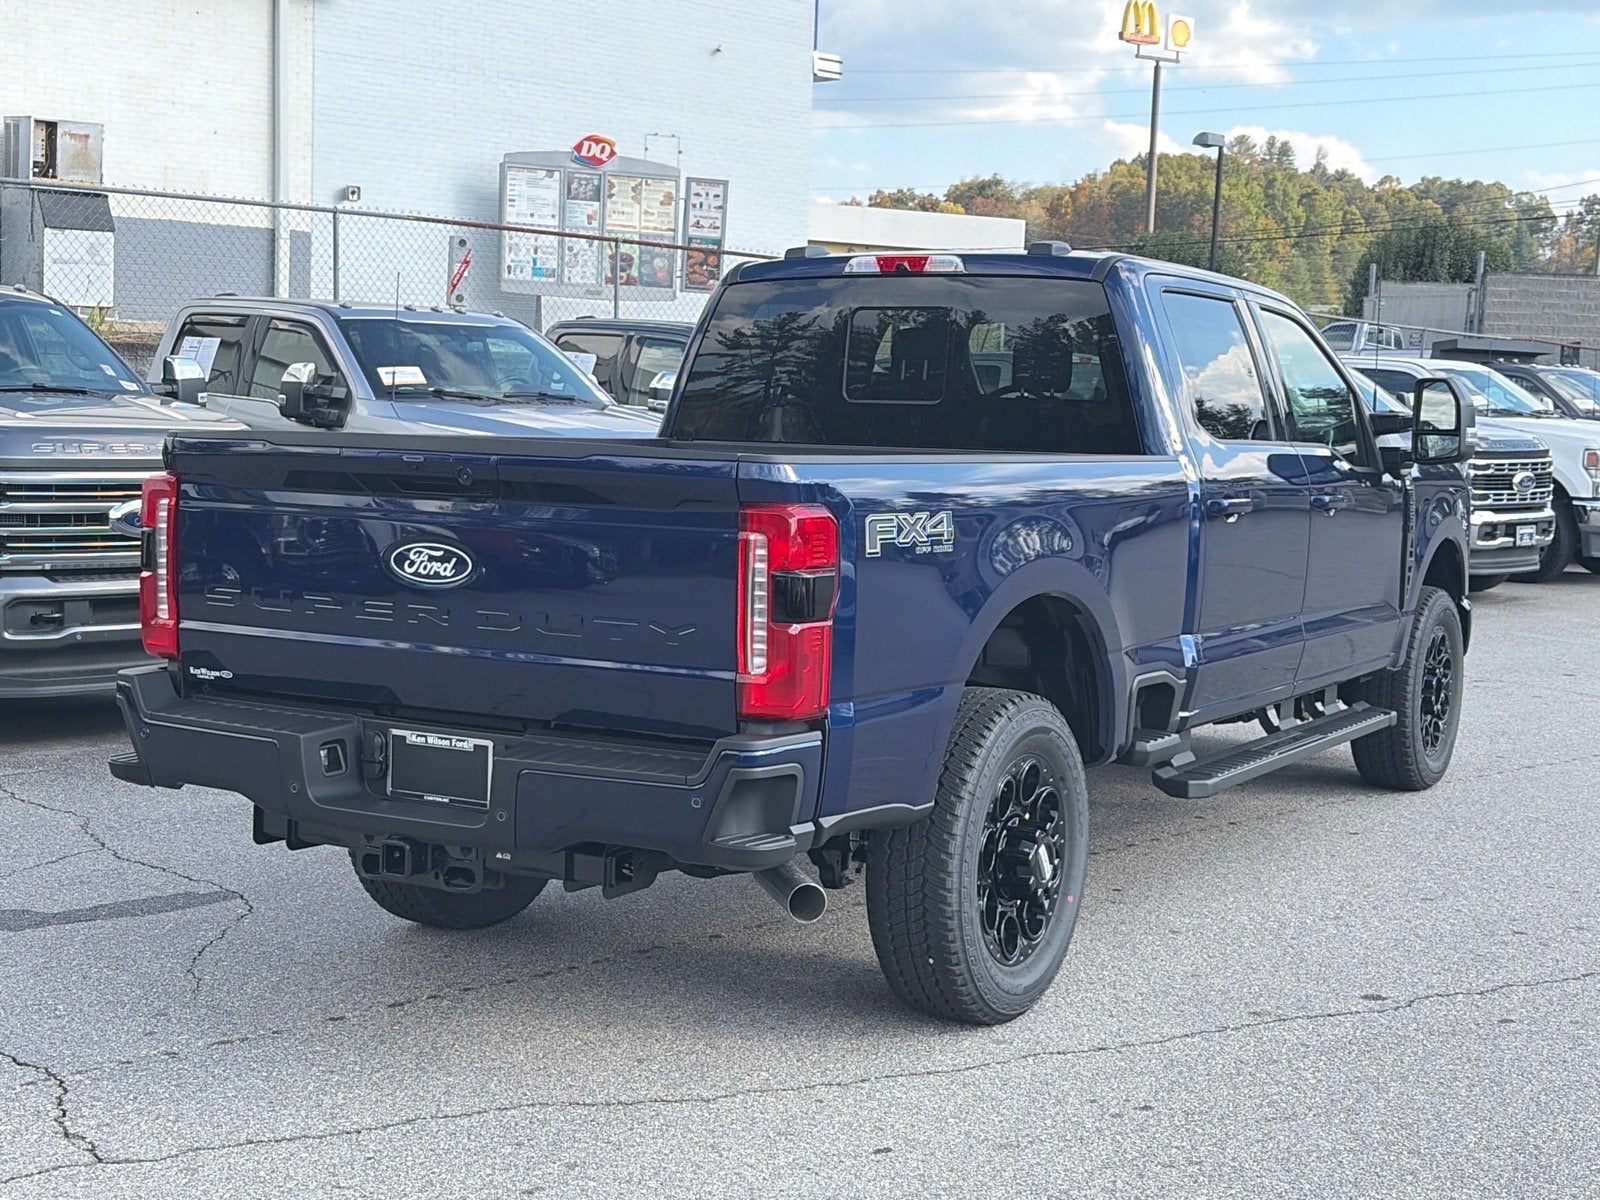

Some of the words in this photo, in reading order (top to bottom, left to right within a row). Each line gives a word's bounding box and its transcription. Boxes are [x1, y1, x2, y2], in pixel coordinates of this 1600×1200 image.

[581, 140, 611, 161] DQ
[31, 442, 151, 455] SUPER
[865, 510, 954, 557] FX4
[404, 547, 458, 577] Ford
[205, 586, 449, 626] SUPER
[476, 610, 696, 646] DUTY
[411, 733, 426, 744] Ken
[427, 735, 451, 747] Wilson
[452, 739, 469, 749] Ford
